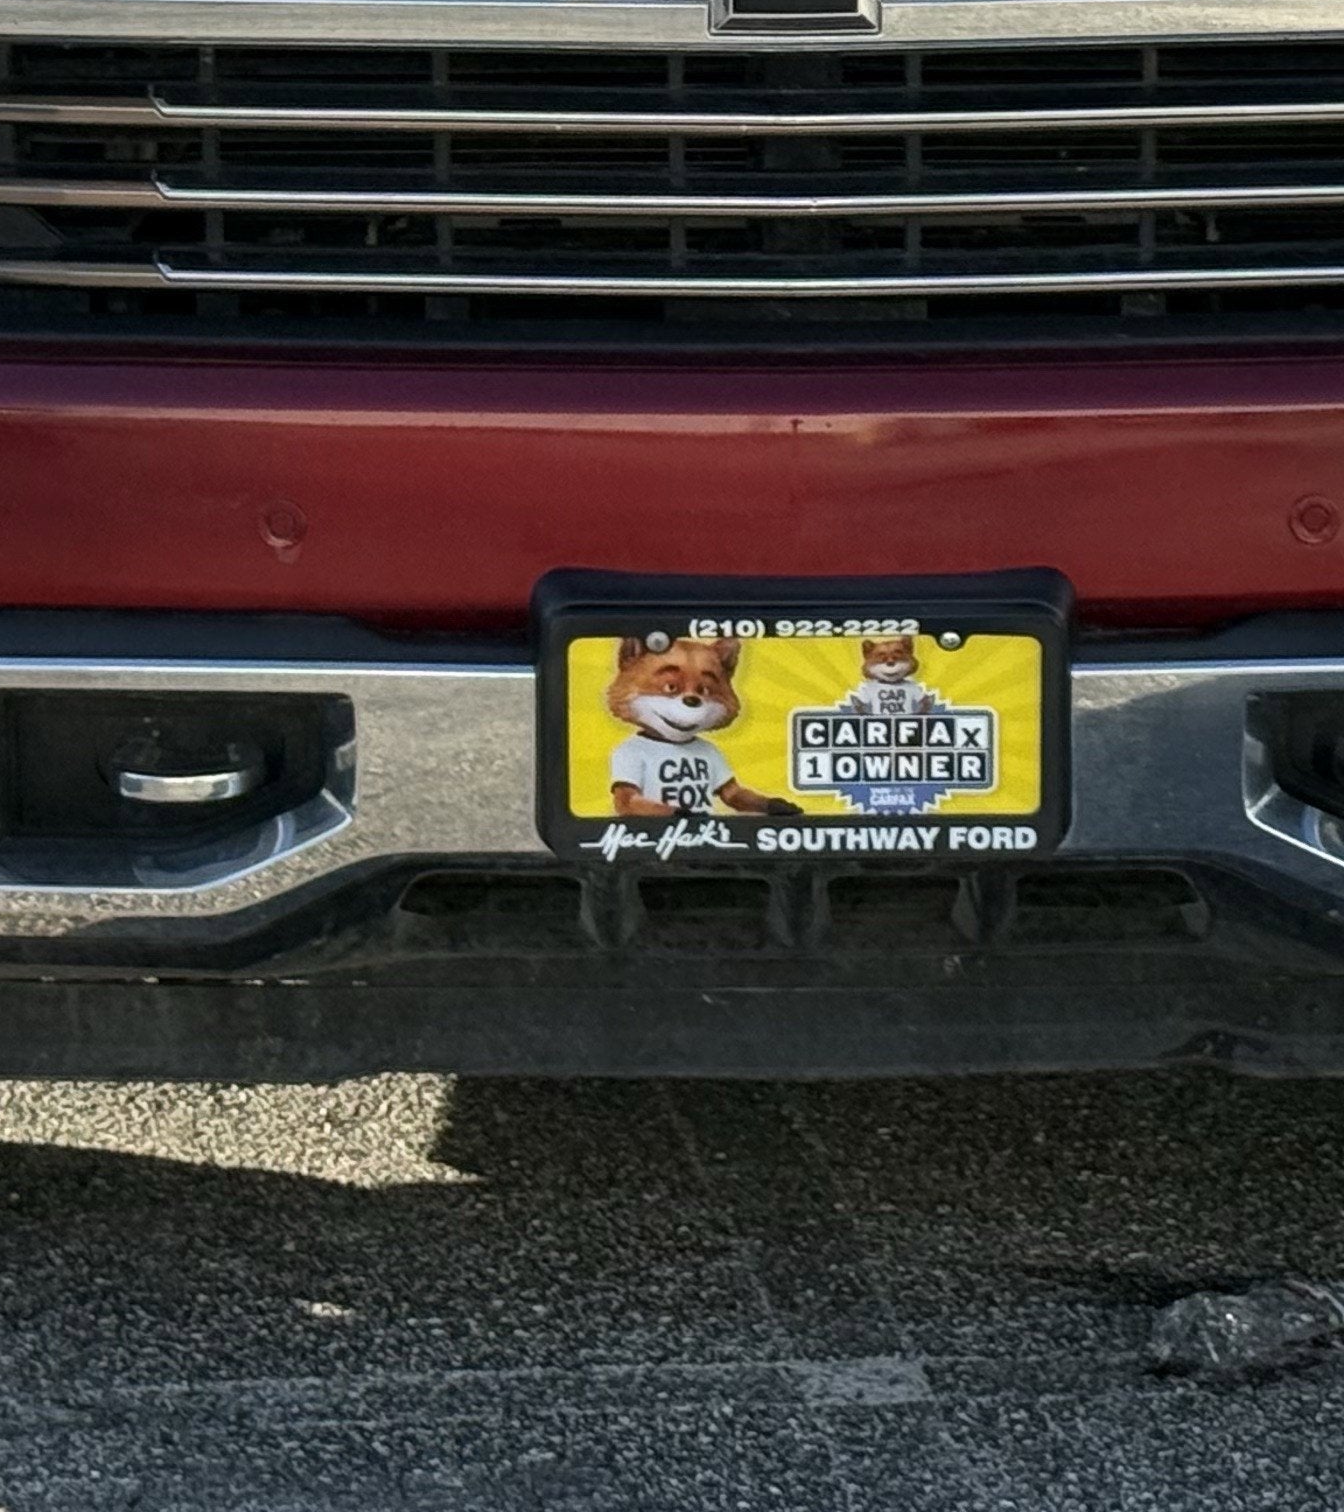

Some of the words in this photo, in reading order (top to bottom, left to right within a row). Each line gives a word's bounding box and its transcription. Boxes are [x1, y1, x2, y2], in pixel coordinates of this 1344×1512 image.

[688, 618, 766, 639] (210)
[774, 618, 920, 637] 922-2222
[877, 689, 906, 702] CAR
[879, 702, 906, 713] FOX
[804, 721, 982, 748] CARFAX
[659, 757, 709, 783] CAR
[661, 785, 712, 809] FOX
[756, 824, 940, 852] SOUTHWAY
[949, 825, 1038, 852] FORD
